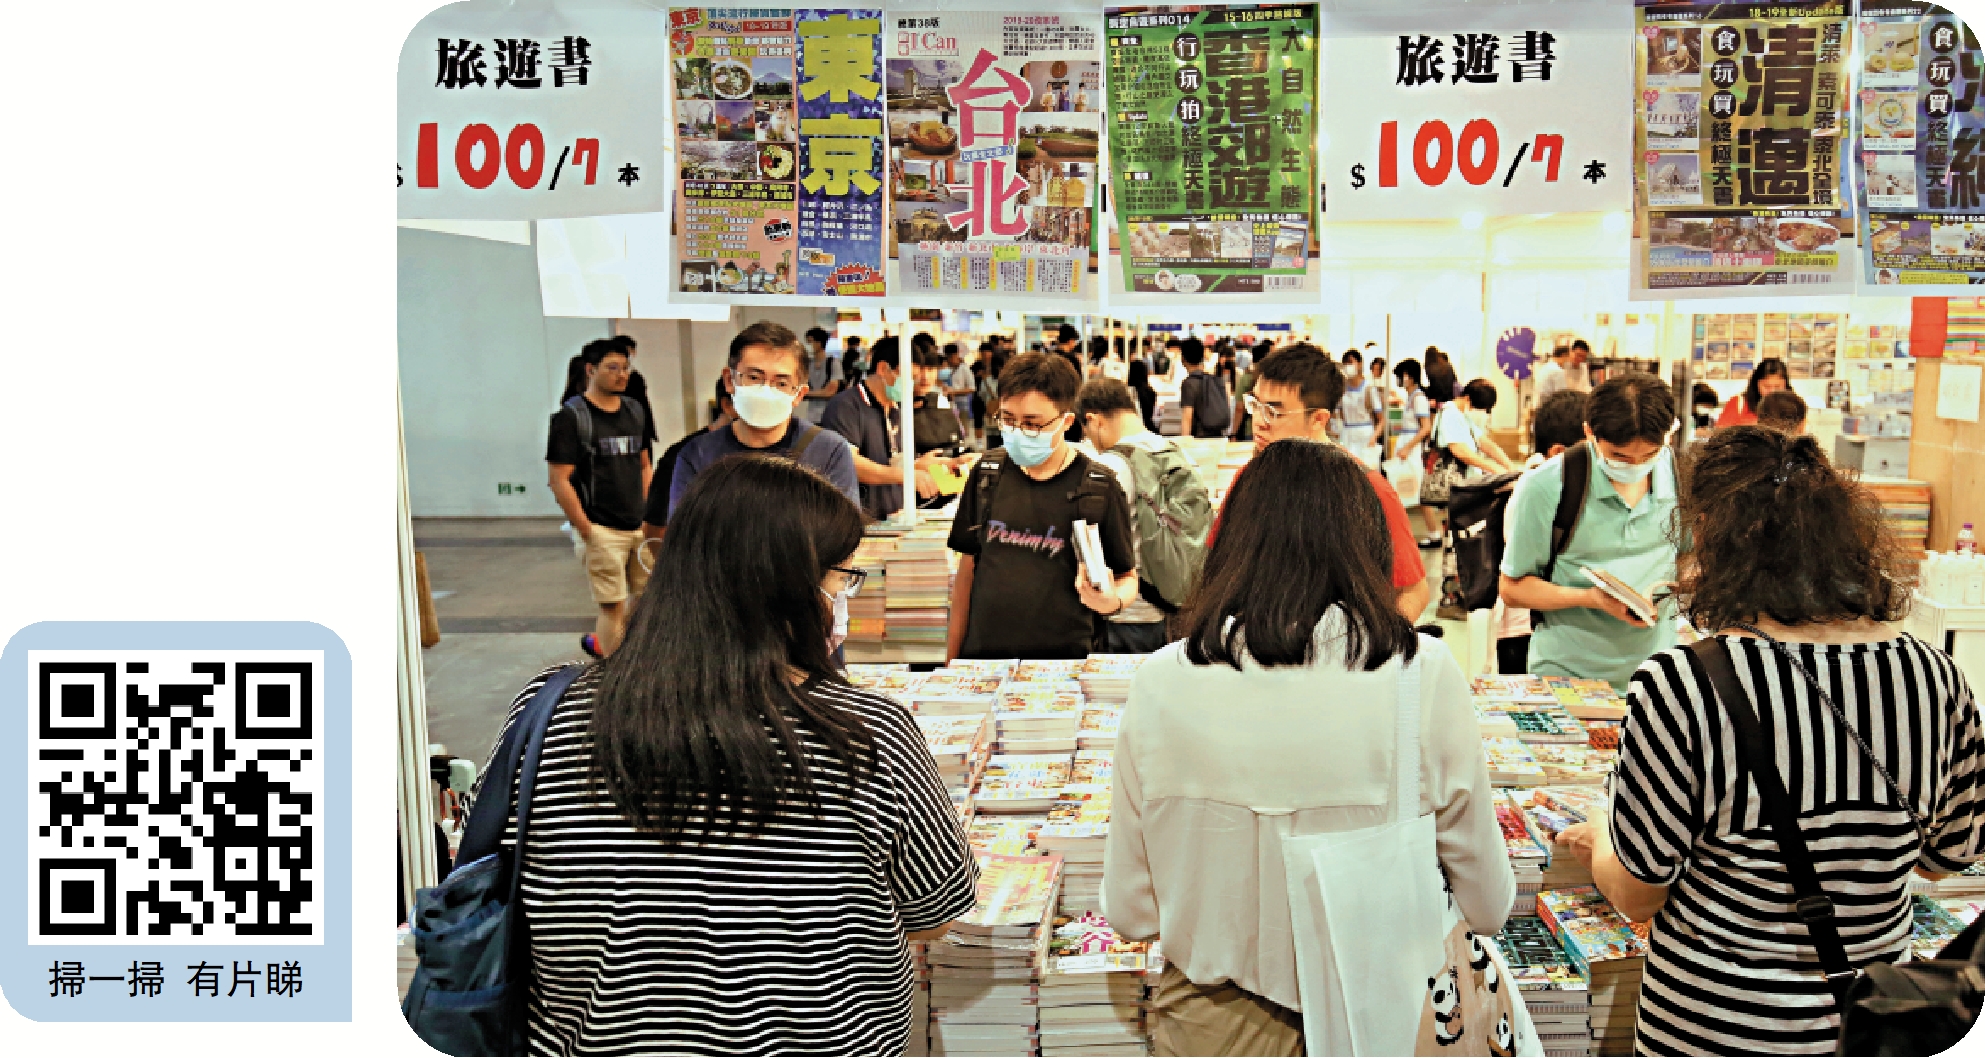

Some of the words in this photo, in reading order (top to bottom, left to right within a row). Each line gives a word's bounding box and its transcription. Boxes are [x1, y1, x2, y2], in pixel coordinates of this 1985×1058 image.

[437, 36, 592, 89] 旅遊書
[921, 31, 957, 51] Can
[1396, 31, 1556, 85] 旅遊書
[798, 14, 882, 196] 東京
[947, 49, 1030, 236] 台北
[1203, 28, 1270, 209] 香港郊遊
[1281, 26, 1304, 207] 大自然生態
[1738, 24, 1817, 206] 清邁
[618, 163, 640, 186] 本
[1351, 164, 1366, 188] $
[1583, 160, 1607, 183] 本
